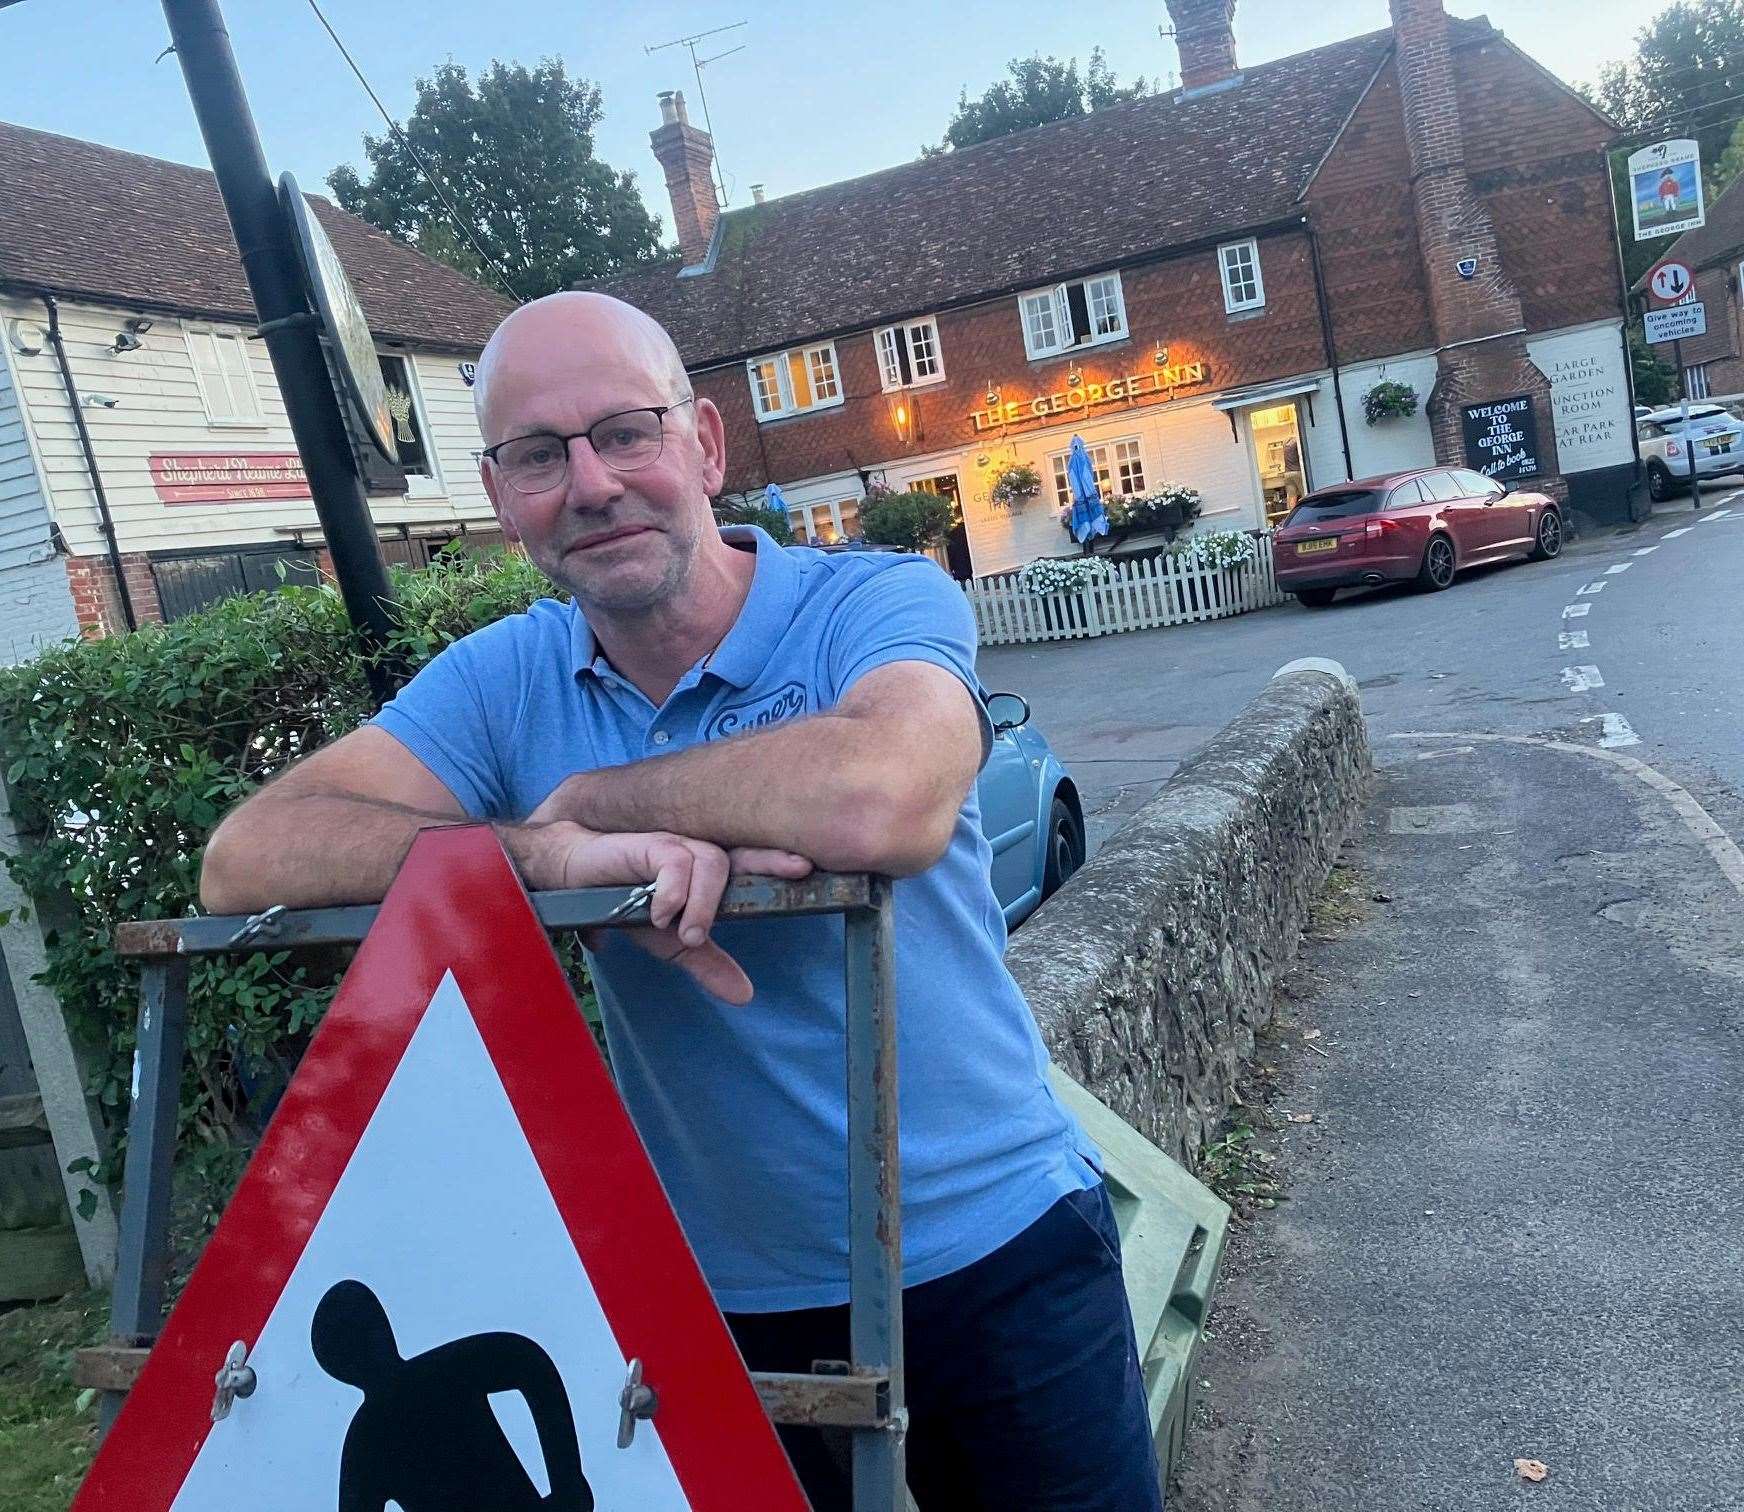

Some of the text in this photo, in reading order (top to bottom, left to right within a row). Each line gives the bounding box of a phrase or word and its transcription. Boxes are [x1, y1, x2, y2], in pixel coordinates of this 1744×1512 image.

[1638, 228, 1652, 239] THE
[1654, 223, 1686, 235] GEORGE
[1647, 306, 1702, 323] Give way to
[1653, 317, 1697, 330] oncoming
[1657, 326, 1695, 338] vehicles
[1555, 357, 1597, 372] LARGE
[1550, 366, 1604, 384] GARDEN
[970, 361, 1204, 428] THE GEORGE INN
[1553, 385, 1615, 406] UNCTION
[1468, 400, 1528, 420] WELCOME
[1561, 400, 1601, 416] ROOM
[1490, 414, 1508, 425] TO
[1583, 420, 1616, 433] PARK
[1487, 423, 1512, 436] THE
[1478, 431, 1524, 448] GEORGE
[1559, 431, 1612, 449] AT REAR
[1492, 443, 1513, 456] INN
[1480, 461, 1498, 476] Call
[1497, 459, 1506, 471] to
[1506, 447, 1527, 467] book
[160, 458, 232, 486] Shepherd
[231, 457, 282, 481] Neame
